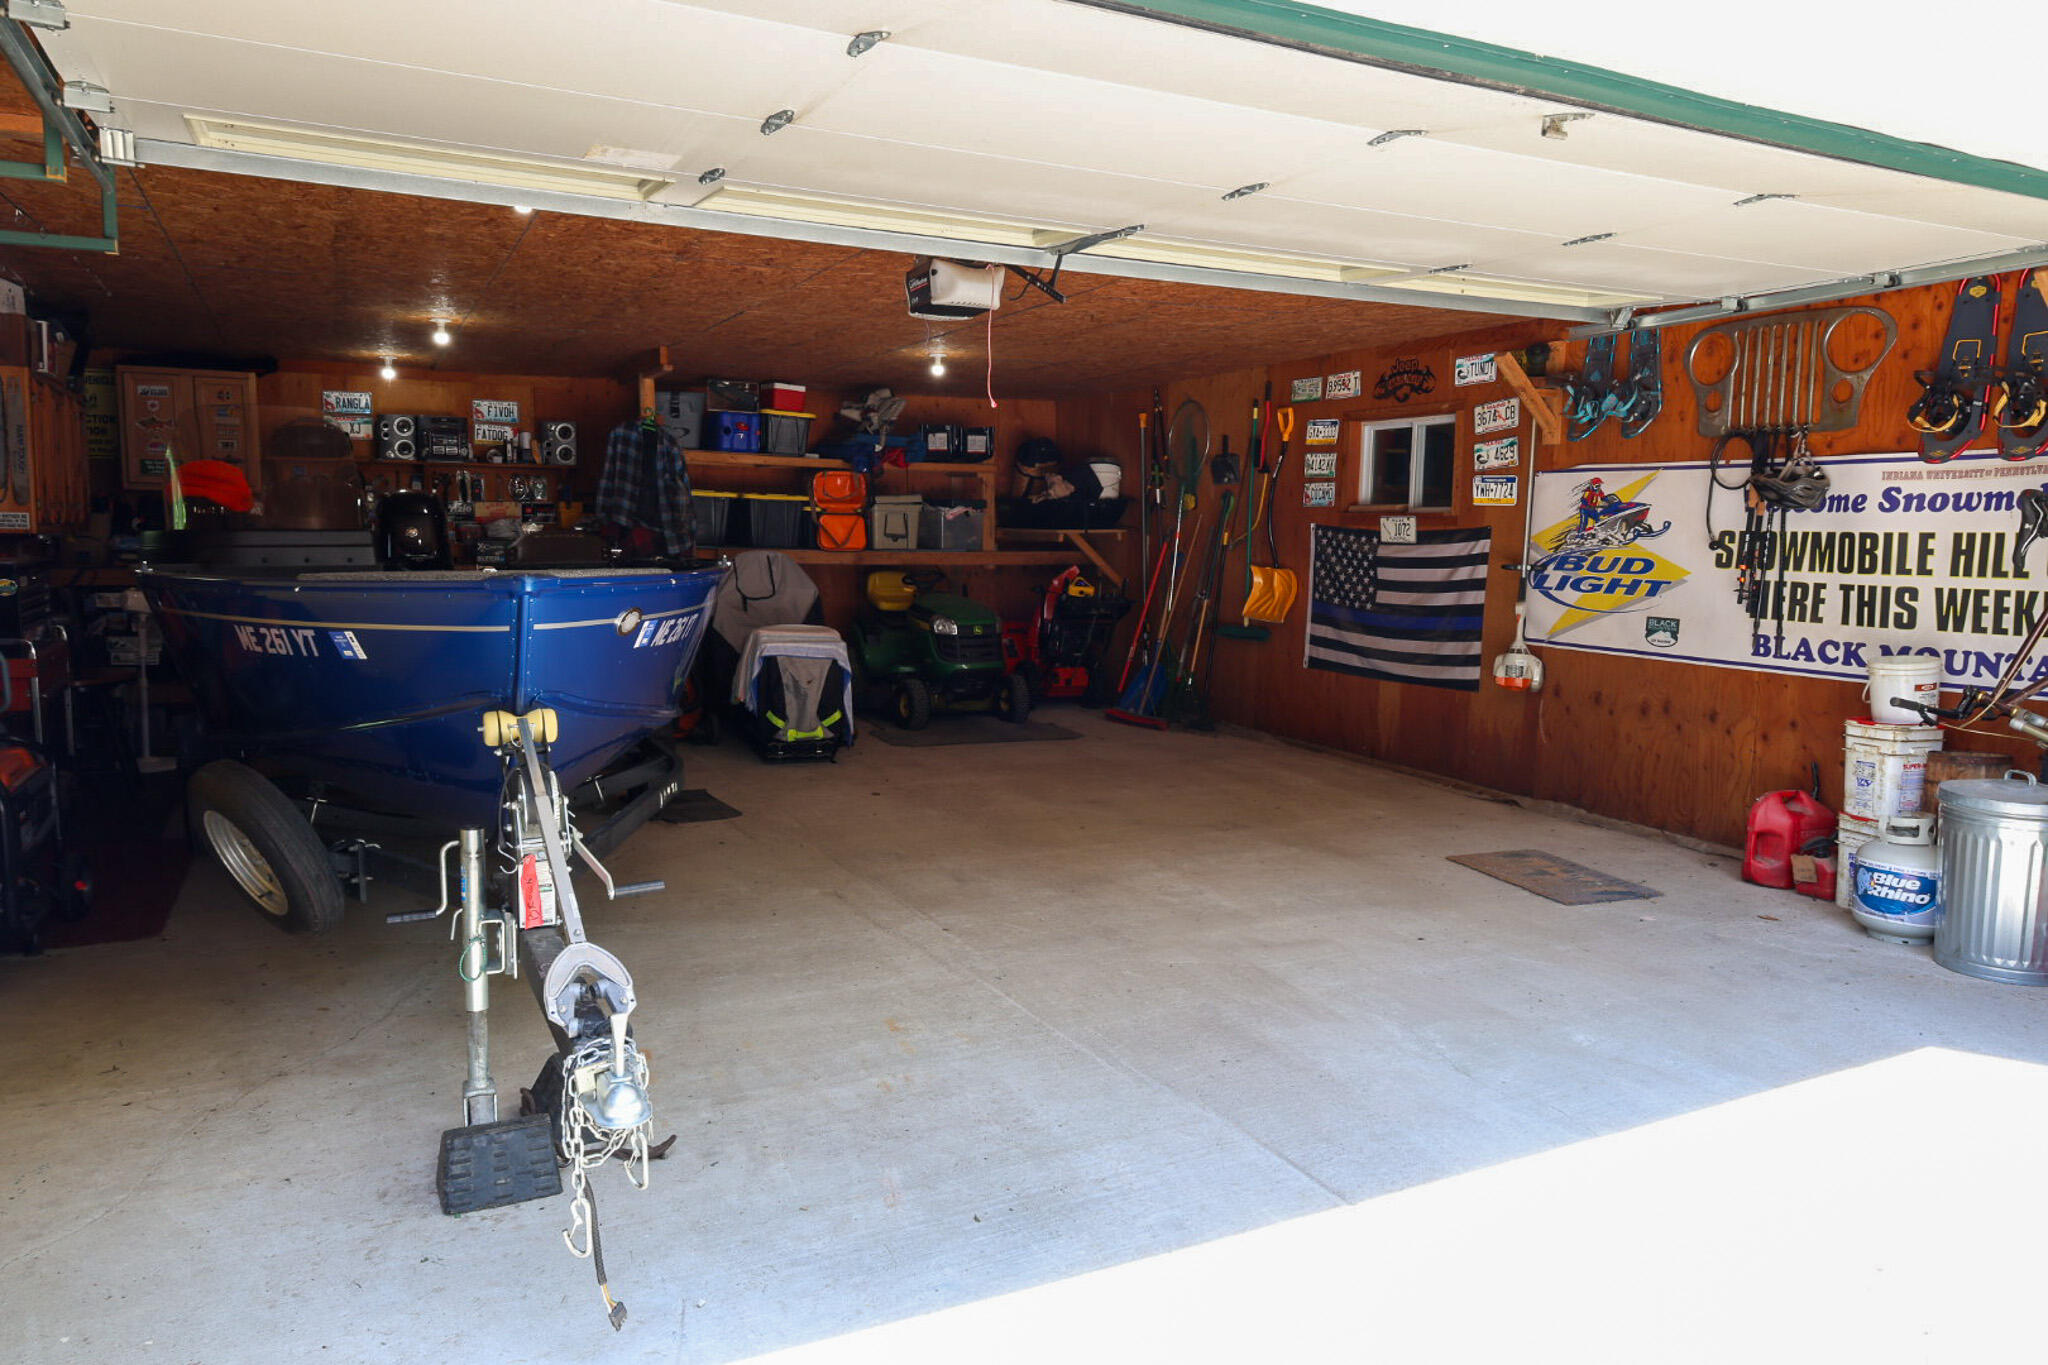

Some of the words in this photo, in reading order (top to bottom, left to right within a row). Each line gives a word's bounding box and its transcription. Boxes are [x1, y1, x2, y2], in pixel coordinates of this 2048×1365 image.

[1881, 470, 1924, 481] INDIANA
[1927, 468, 1985, 480] UNIVERSITY
[1878, 483, 2048, 513] Snowm
[1394, 522, 1411, 537] 1072
[1552, 555, 1655, 575] BUD
[1532, 574, 1673, 597] LIGHT
[1839, 584, 1919, 630] THIS
[1935, 587, 2048, 637] WEEK
[1649, 619, 1678, 627] BLACK
[234, 624, 264, 653] ME
[259, 627, 295, 656] 261
[290, 629, 320, 657] YT
[1751, 634, 1868, 668] BLACK
[1873, 872, 1921, 891] Blue
[1868, 885, 1931, 905] Rhino
